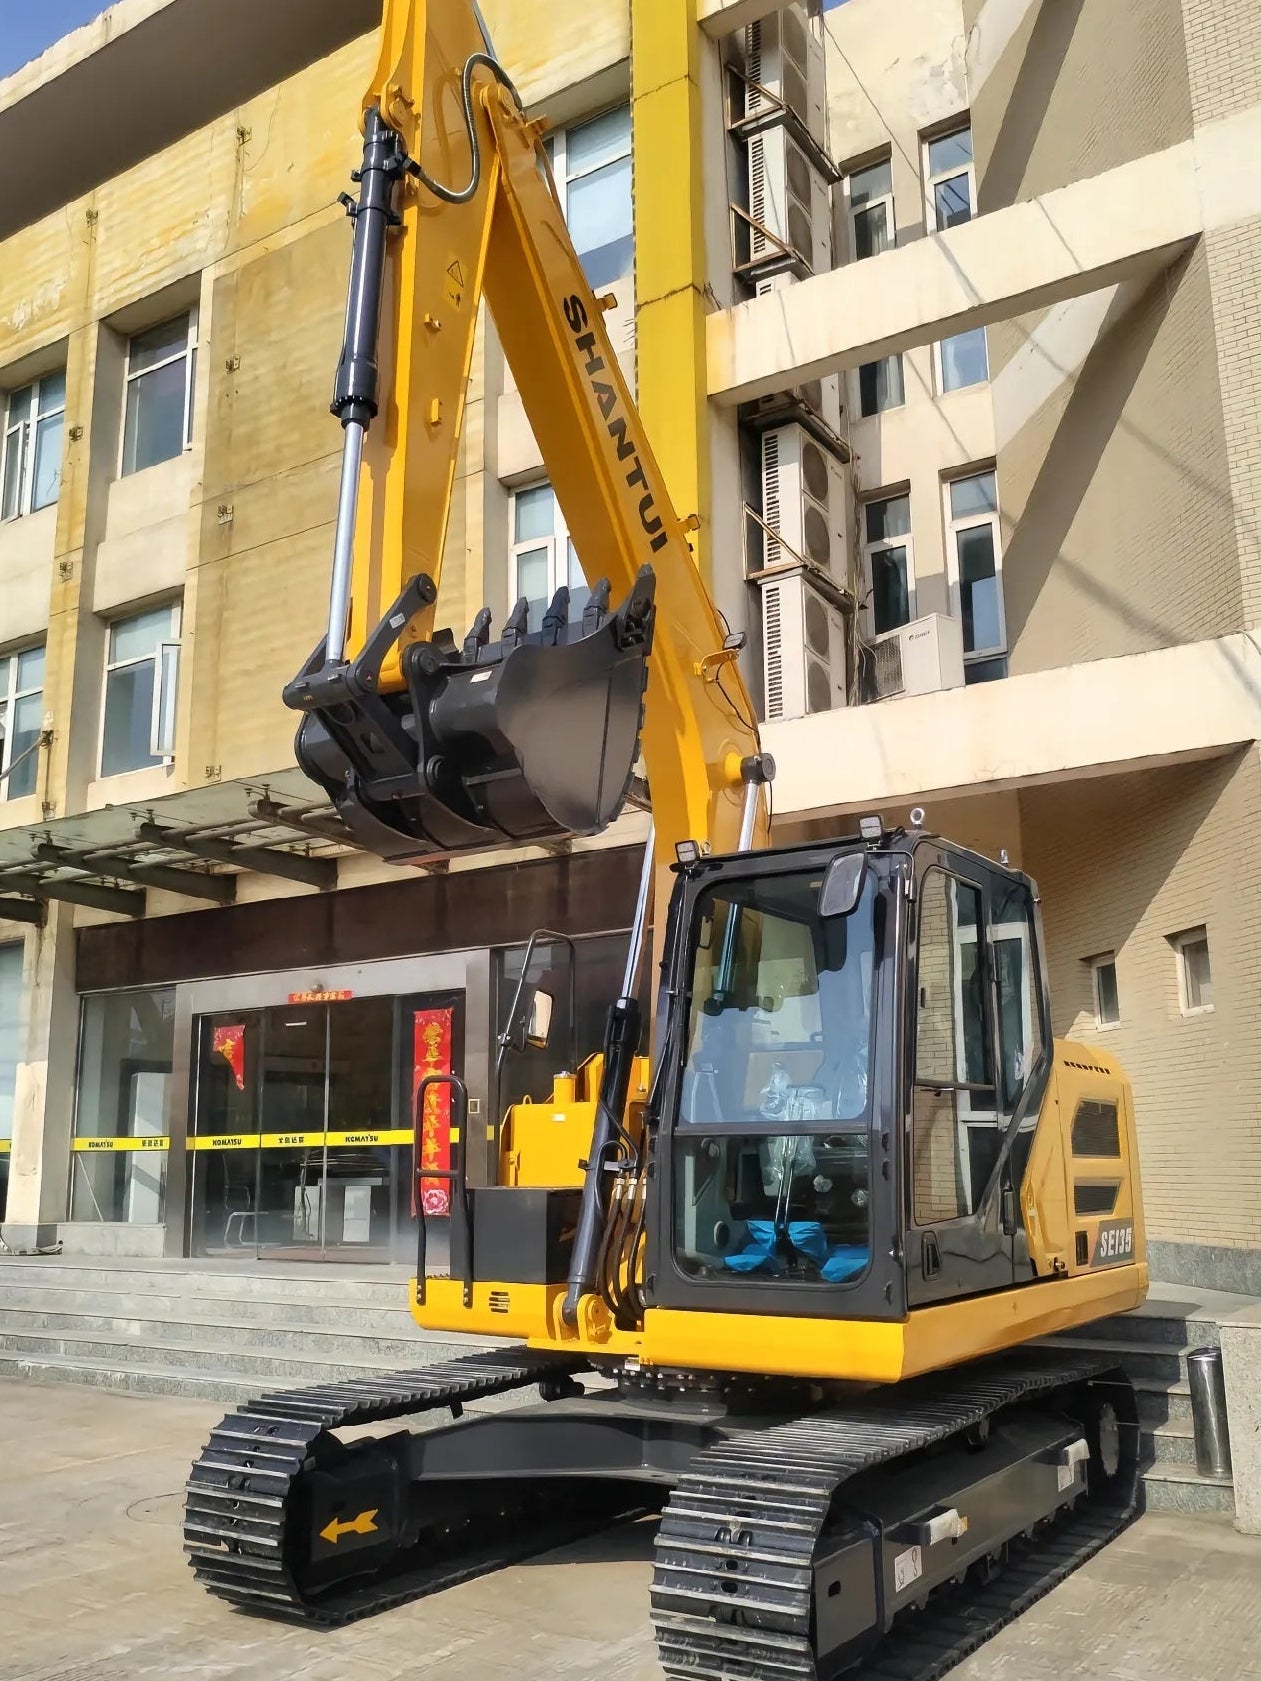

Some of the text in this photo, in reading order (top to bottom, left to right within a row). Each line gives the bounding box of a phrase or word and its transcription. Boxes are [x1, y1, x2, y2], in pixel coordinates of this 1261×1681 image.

[563, 294, 668, 554] SHANTUI
[212, 1138, 242, 1146] KOMATSU
[345, 1134, 379, 1143] KOMATSU
[1100, 1227, 1132, 1257] SE135
